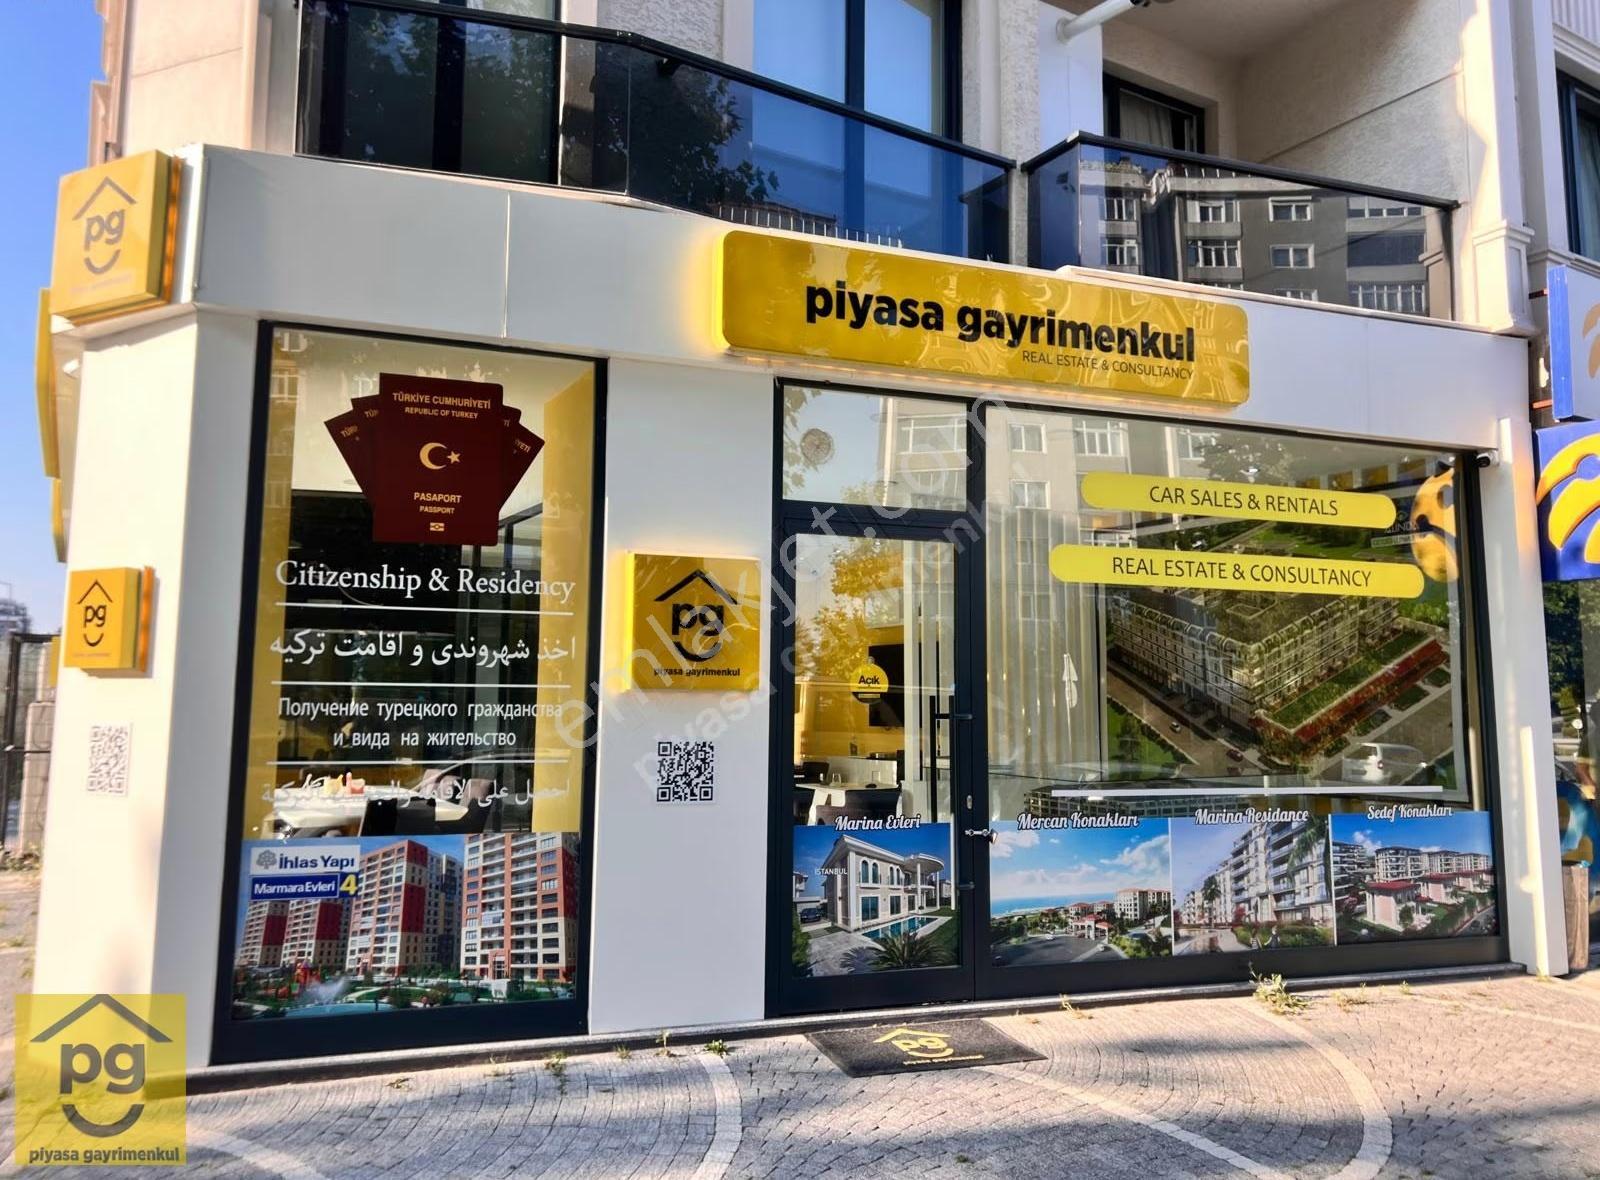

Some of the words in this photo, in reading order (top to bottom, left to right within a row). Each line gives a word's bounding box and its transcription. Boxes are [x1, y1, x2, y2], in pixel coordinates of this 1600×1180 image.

[83, 207, 126, 252] pg
[806, 280, 944, 331] piyasa
[957, 305, 1195, 362] gayrimenkul
[1022, 351, 1053, 366] REAL
[1056, 354, 1099, 370] ESTATE
[1101, 357, 1110, 370] &
[1112, 359, 1194, 380] CONSULTANCY
[392, 391, 430, 404] TÜRKİYE
[432, 395, 491, 410] CUMHURİYETİ
[405, 406, 438, 416] REPUBLIC
[440, 409, 450, 417] OF
[451, 409, 478, 419] TURKEY
[413, 492, 461, 503] PASAPORT
[1149, 486, 1185, 504] CAR
[1191, 489, 1243, 509] SALES
[1248, 494, 1260, 511] &
[1266, 496, 1338, 516] RENTALS
[419, 505, 455, 514] PASSPORT
[275, 560, 421, 598] Citizenship
[428, 568, 450, 592] &
[458, 571, 576, 603] Residency
[1112, 557, 1159, 576] REAL
[1165, 560, 1226, 579] ESTATE
[1232, 564, 1246, 580] &
[1250, 565, 1372, 587] CONSULTANCY
[84, 604, 107, 628] pg
[671, 602, 724, 636] pg
[410, 649, 423, 666] و
[537, 636, 576, 660] اخذ
[858, 676, 881, 688] Açık
[279, 697, 369, 718] Получение
[376, 701, 457, 720] турецкого
[467, 702, 563, 720] гражданства
[334, 732, 344, 746] и
[352, 731, 390, 749] вида
[401, 732, 419, 746] на
[427, 731, 516, 747] жительство
[835, 814, 882, 831] Marina
[886, 813, 921, 831] Evleri
[1017, 811, 1069, 830] Mercan
[1072, 811, 1140, 829] Konakları
[1195, 807, 1246, 825] Marina
[1246, 806, 1309, 825] Residance
[1367, 804, 1397, 822] Sedef
[1398, 804, 1453, 820] Konakları
[278, 852, 318, 870] İhlas
[320, 854, 355, 872] Yapı
[340, 874, 358, 895] 4
